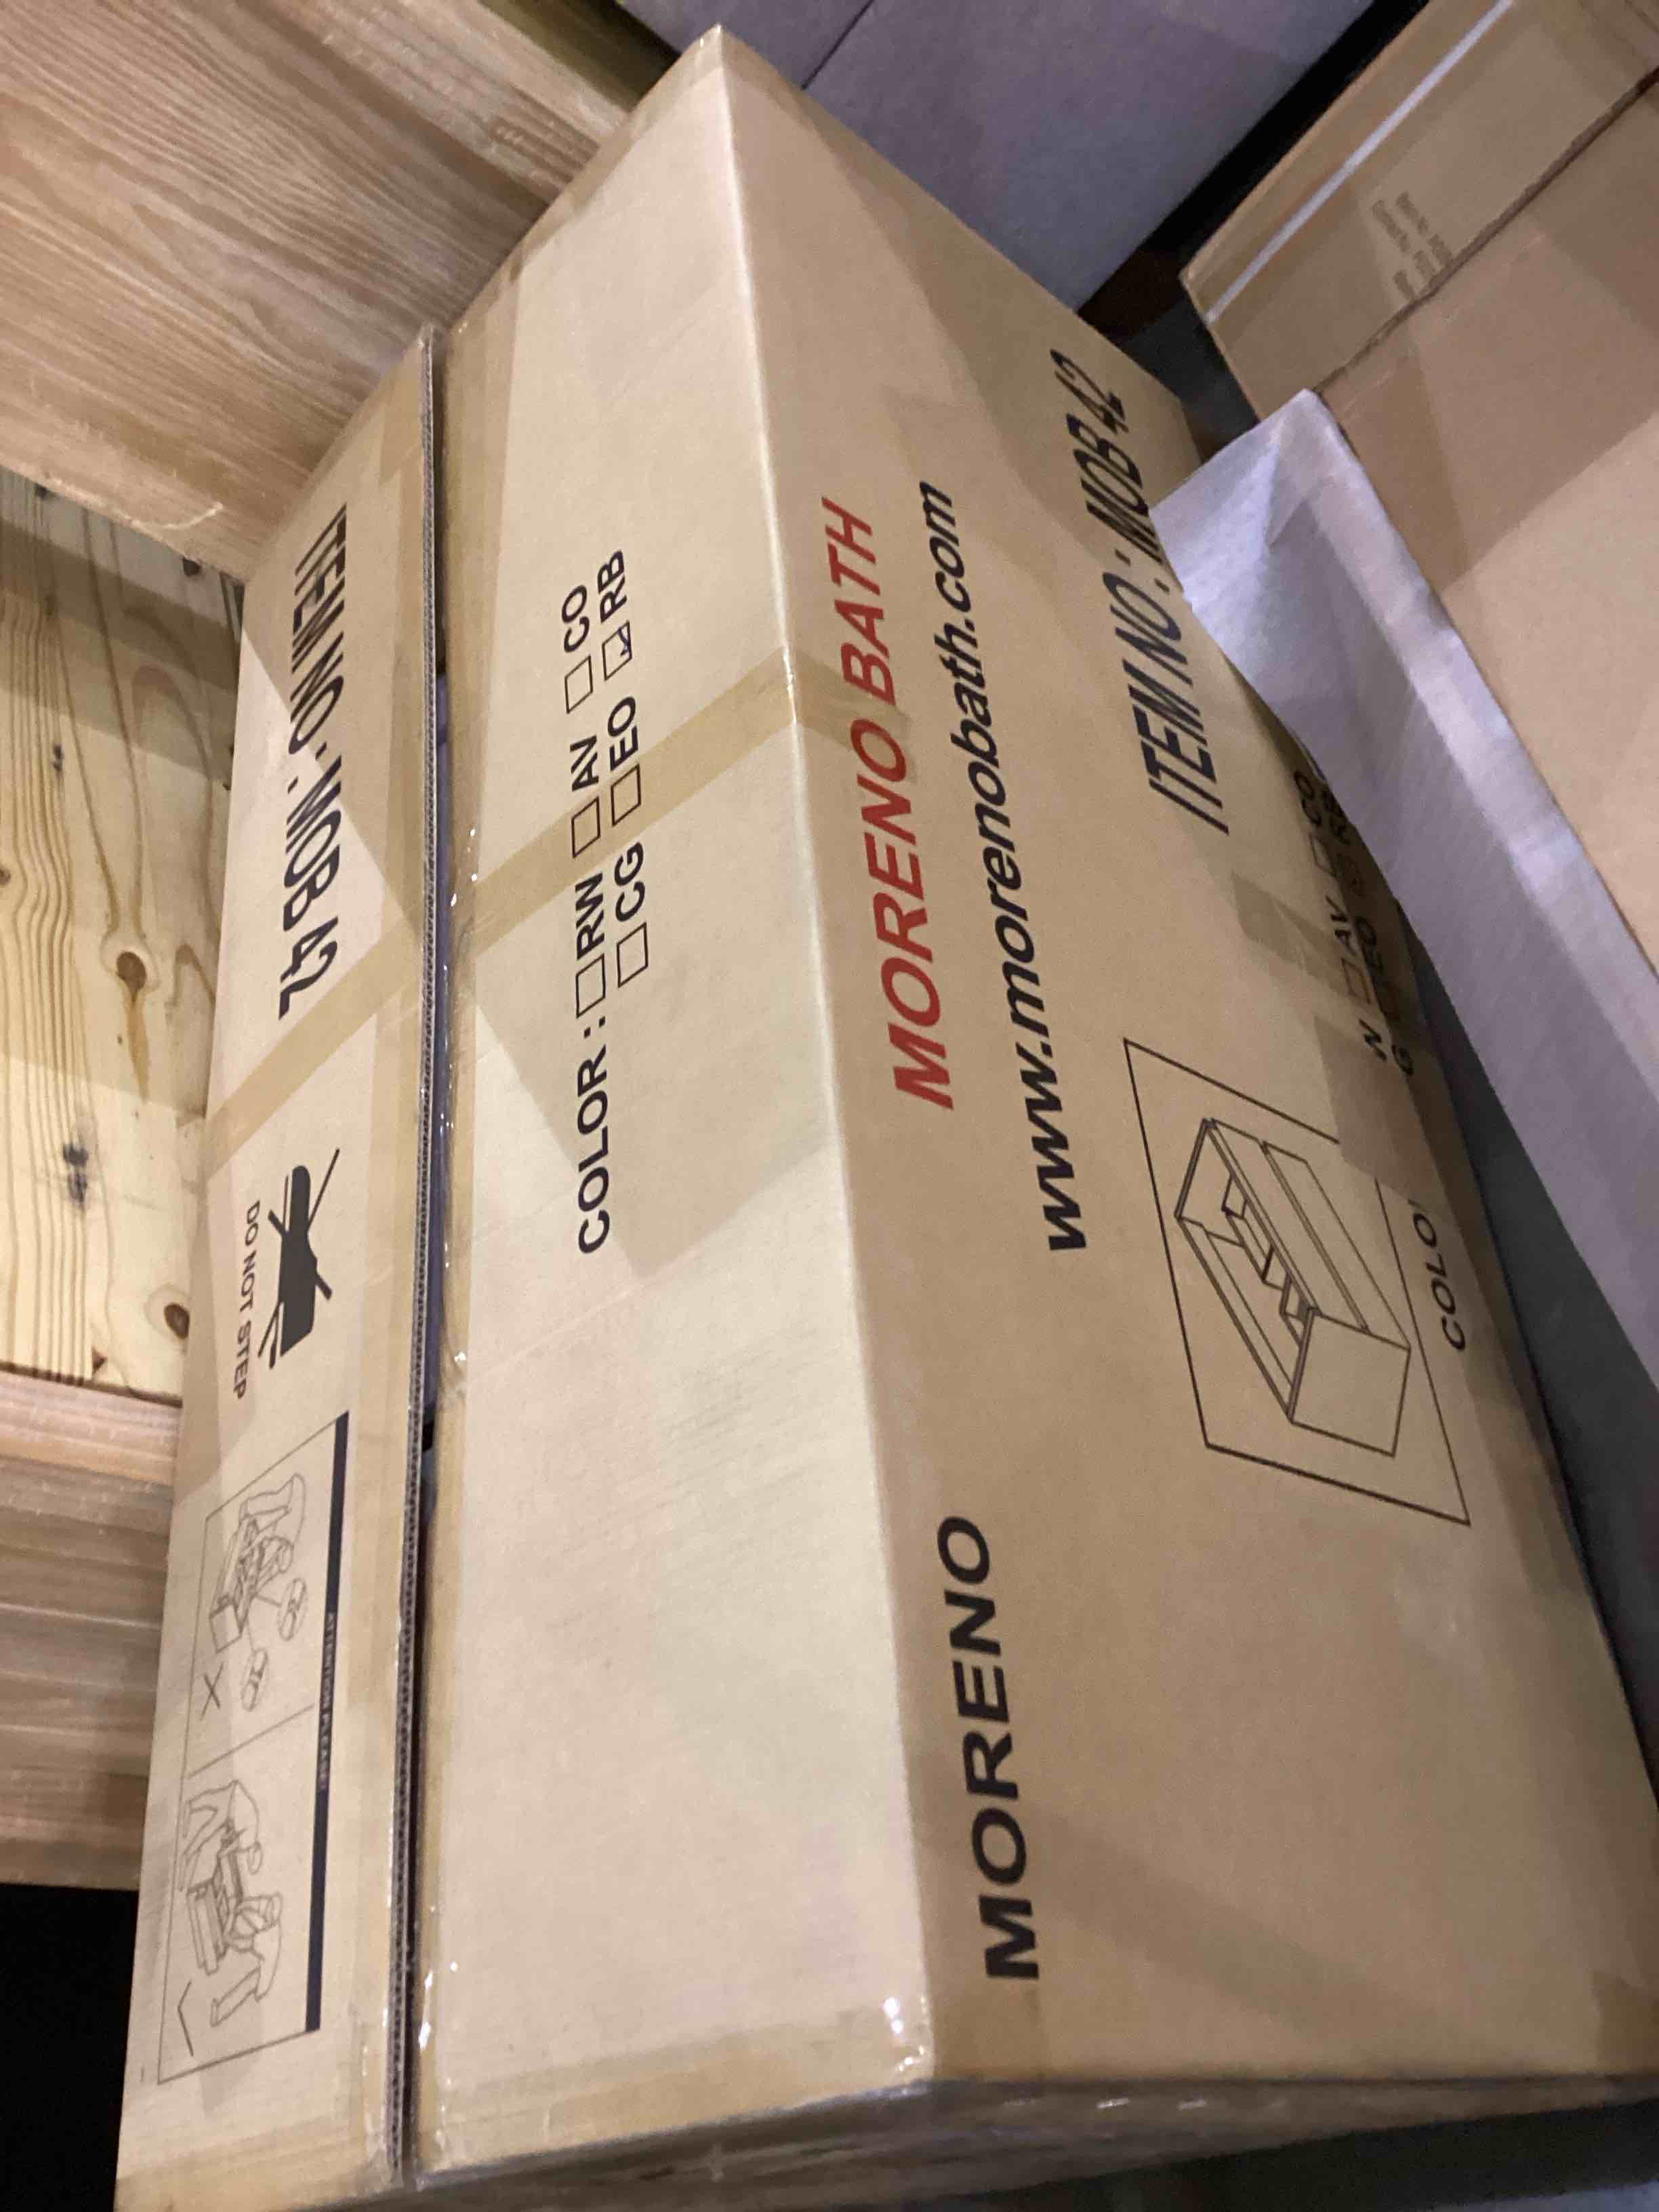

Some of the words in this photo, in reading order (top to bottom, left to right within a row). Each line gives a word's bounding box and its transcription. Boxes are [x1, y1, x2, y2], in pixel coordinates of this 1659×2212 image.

[292, 501, 347, 676] ITEM
[561, 584, 590, 653] CO
[597, 550, 628, 623] RB
[822, 497, 896, 708] BATH
[569, 735, 600, 792] AV
[607, 695, 640, 772] EO
[1122, 658, 1229, 836] ITEM
[614, 842, 646, 922] CG
[920, 479, 1087, 1251] www.morenobath.com
[575, 872, 605, 960] RW
[851, 718, 954, 1111] MORENO
[245, 1200, 260, 1246] DO
[239, 1250, 258, 1313] NOT
[1408, 1198, 1466, 1351] COLO
[233, 1319, 251, 1399] STEP
[937, 1515, 1040, 1981] MORENO
